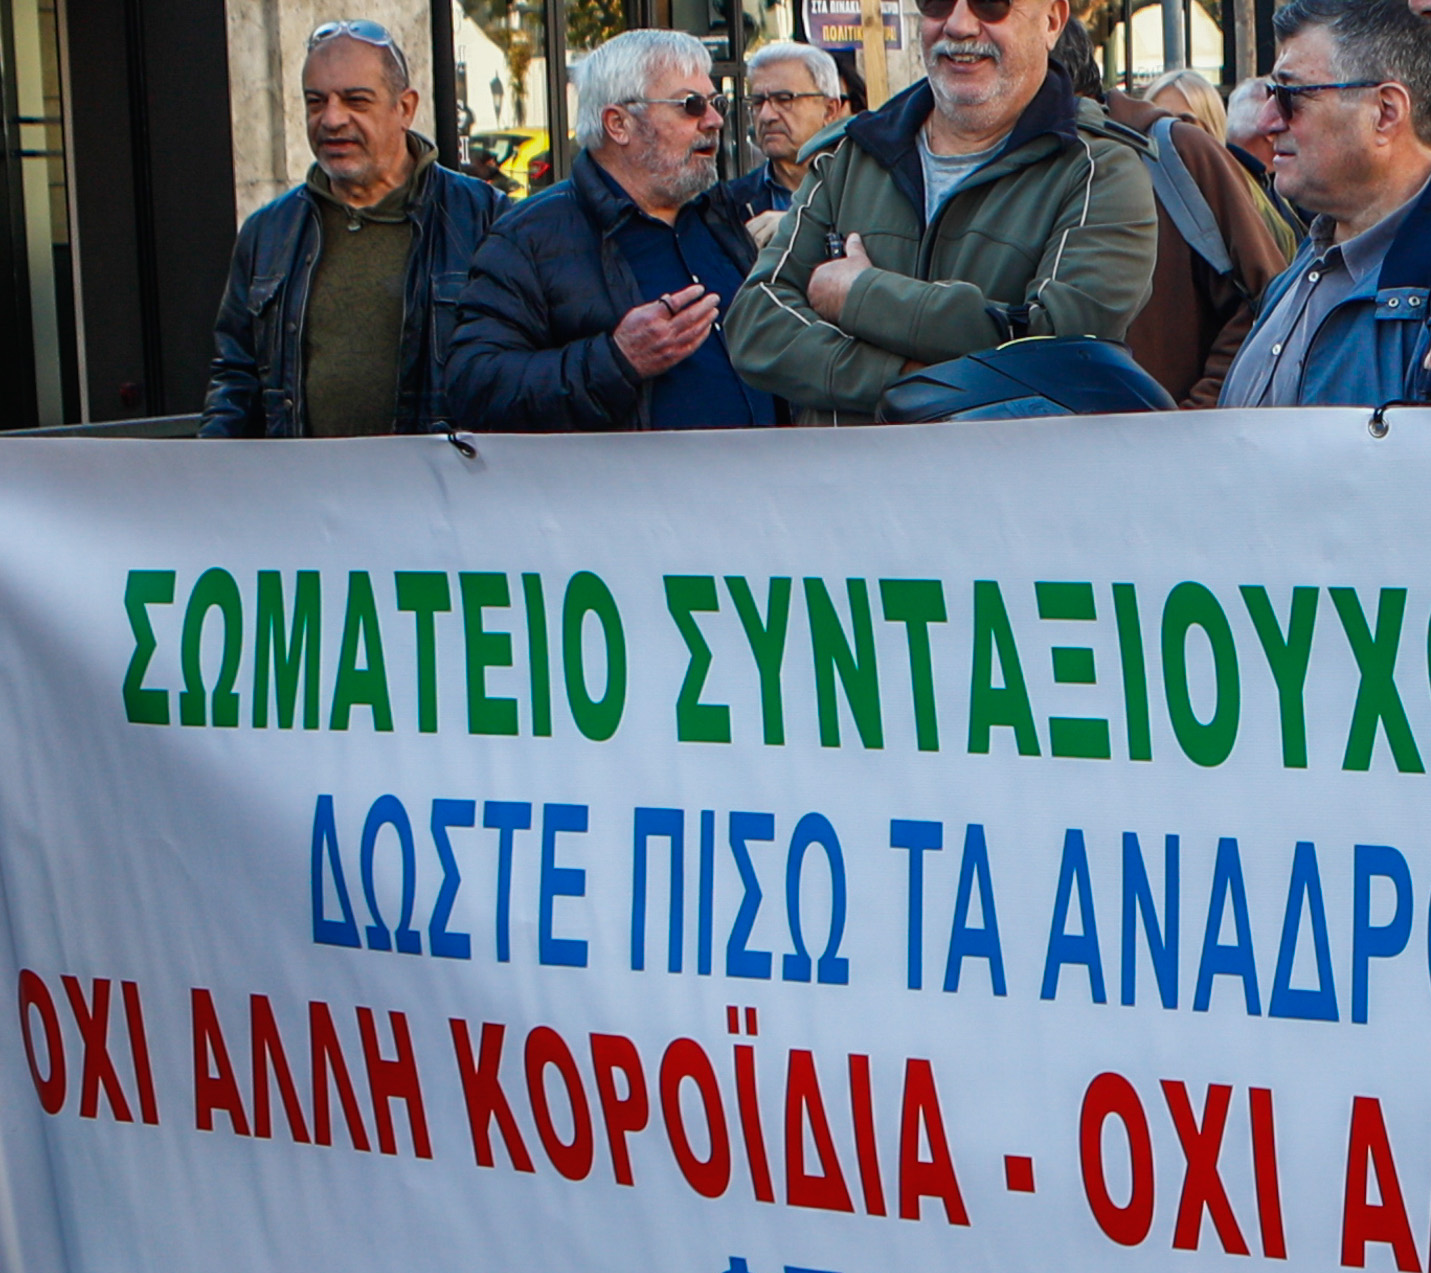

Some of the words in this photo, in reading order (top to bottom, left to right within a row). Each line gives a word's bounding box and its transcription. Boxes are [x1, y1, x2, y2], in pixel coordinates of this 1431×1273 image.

[123, 568, 628, 743] ΣΩΜΑΤΕΙΟ
[307, 792, 590, 969] ΔΩΣΤΕ
[629, 805, 851, 986] ΠΙΣΩ
[888, 817, 1008, 998] ΤΑ
[19, 969, 160, 1126] ΟΧΙ
[190, 988, 433, 1160] ΑΛΛΗ
[449, 1004, 971, 1227] ΚΟΡΟΪΔΙΑ
[1079, 1071, 1288, 1260] ΟΧΙ
